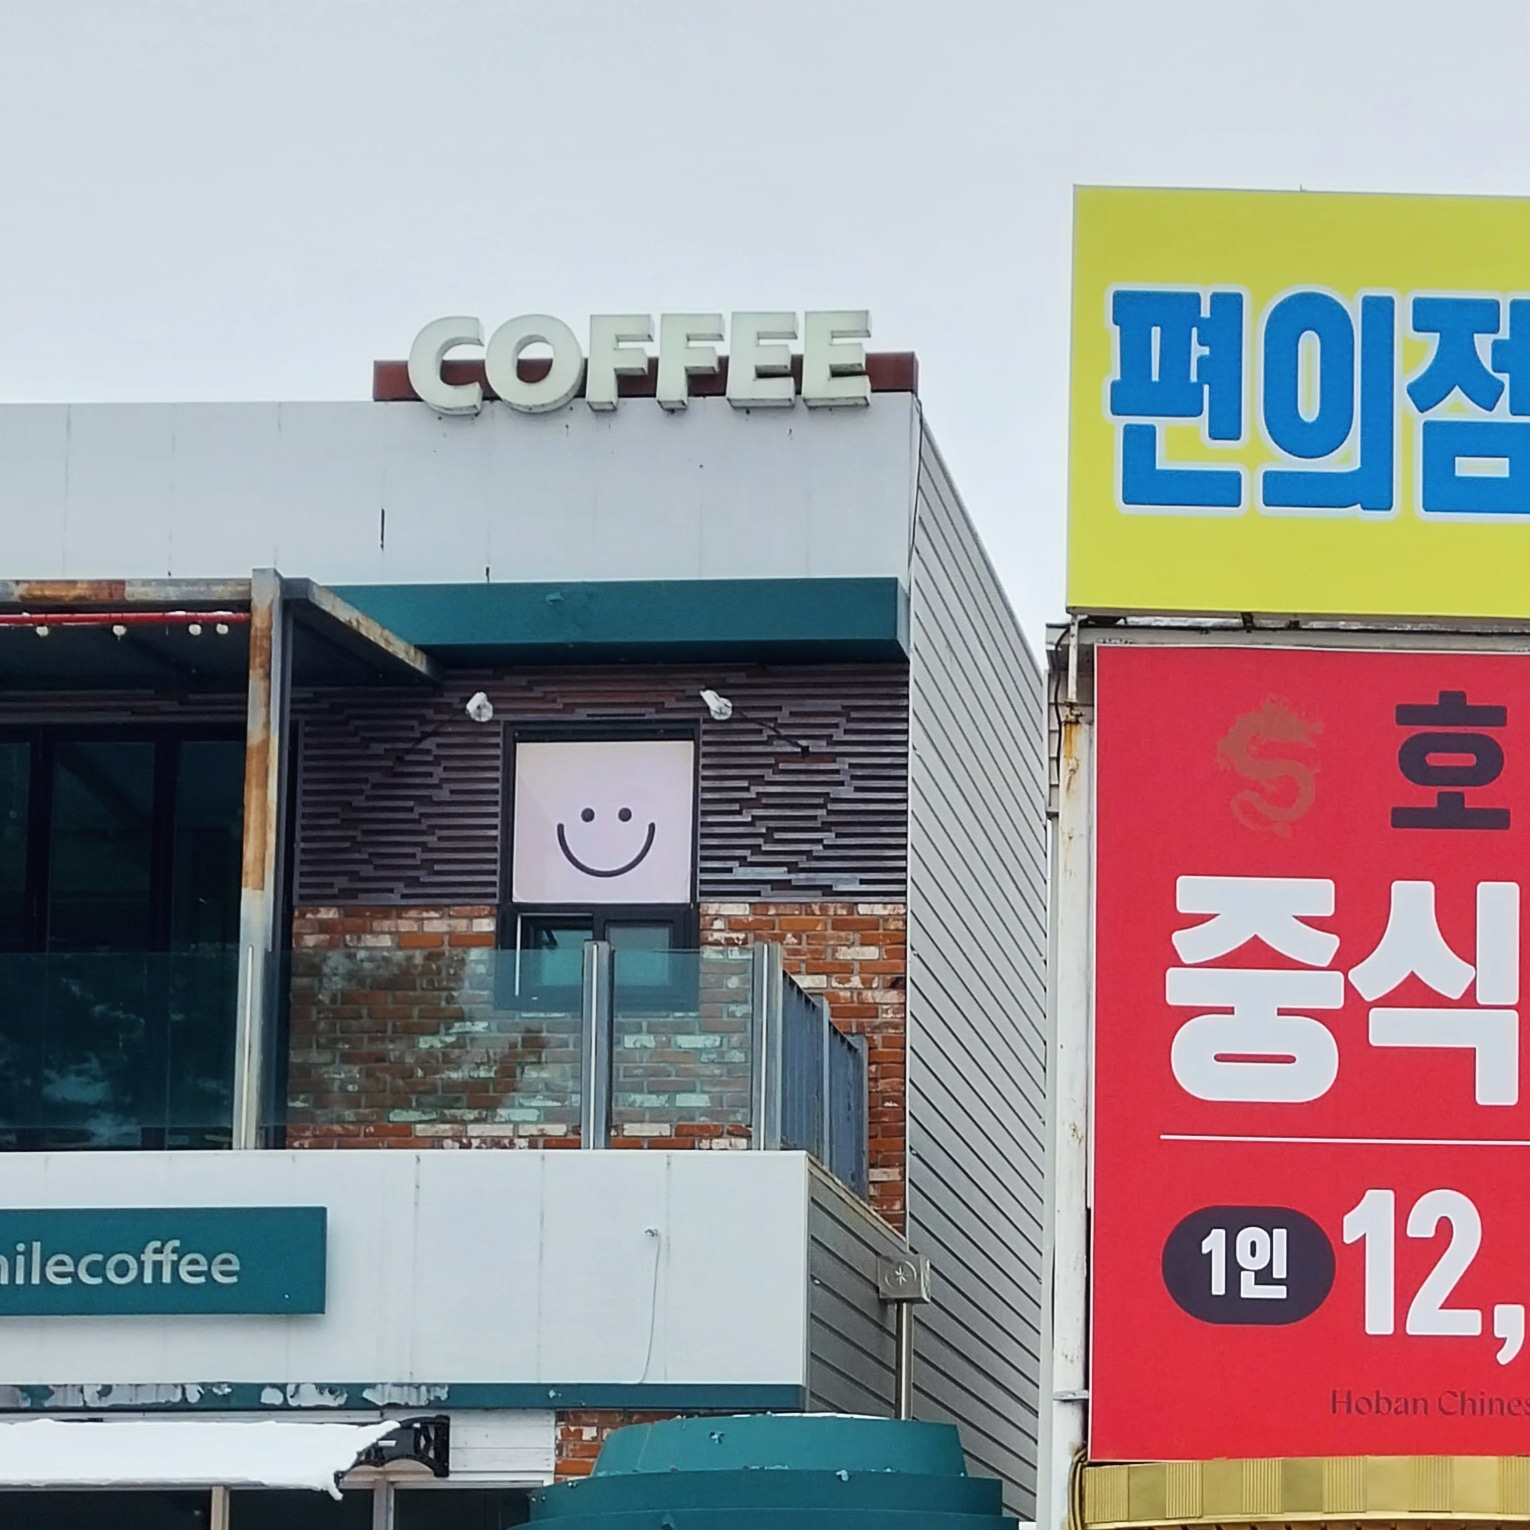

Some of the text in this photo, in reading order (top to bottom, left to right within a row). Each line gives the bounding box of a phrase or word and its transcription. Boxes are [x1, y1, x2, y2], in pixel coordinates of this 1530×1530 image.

[408, 309, 871, 417] COFFEE
[1199, 1227, 1289, 1300] 1인
[1330, 1389, 1429, 1417] Hoban
